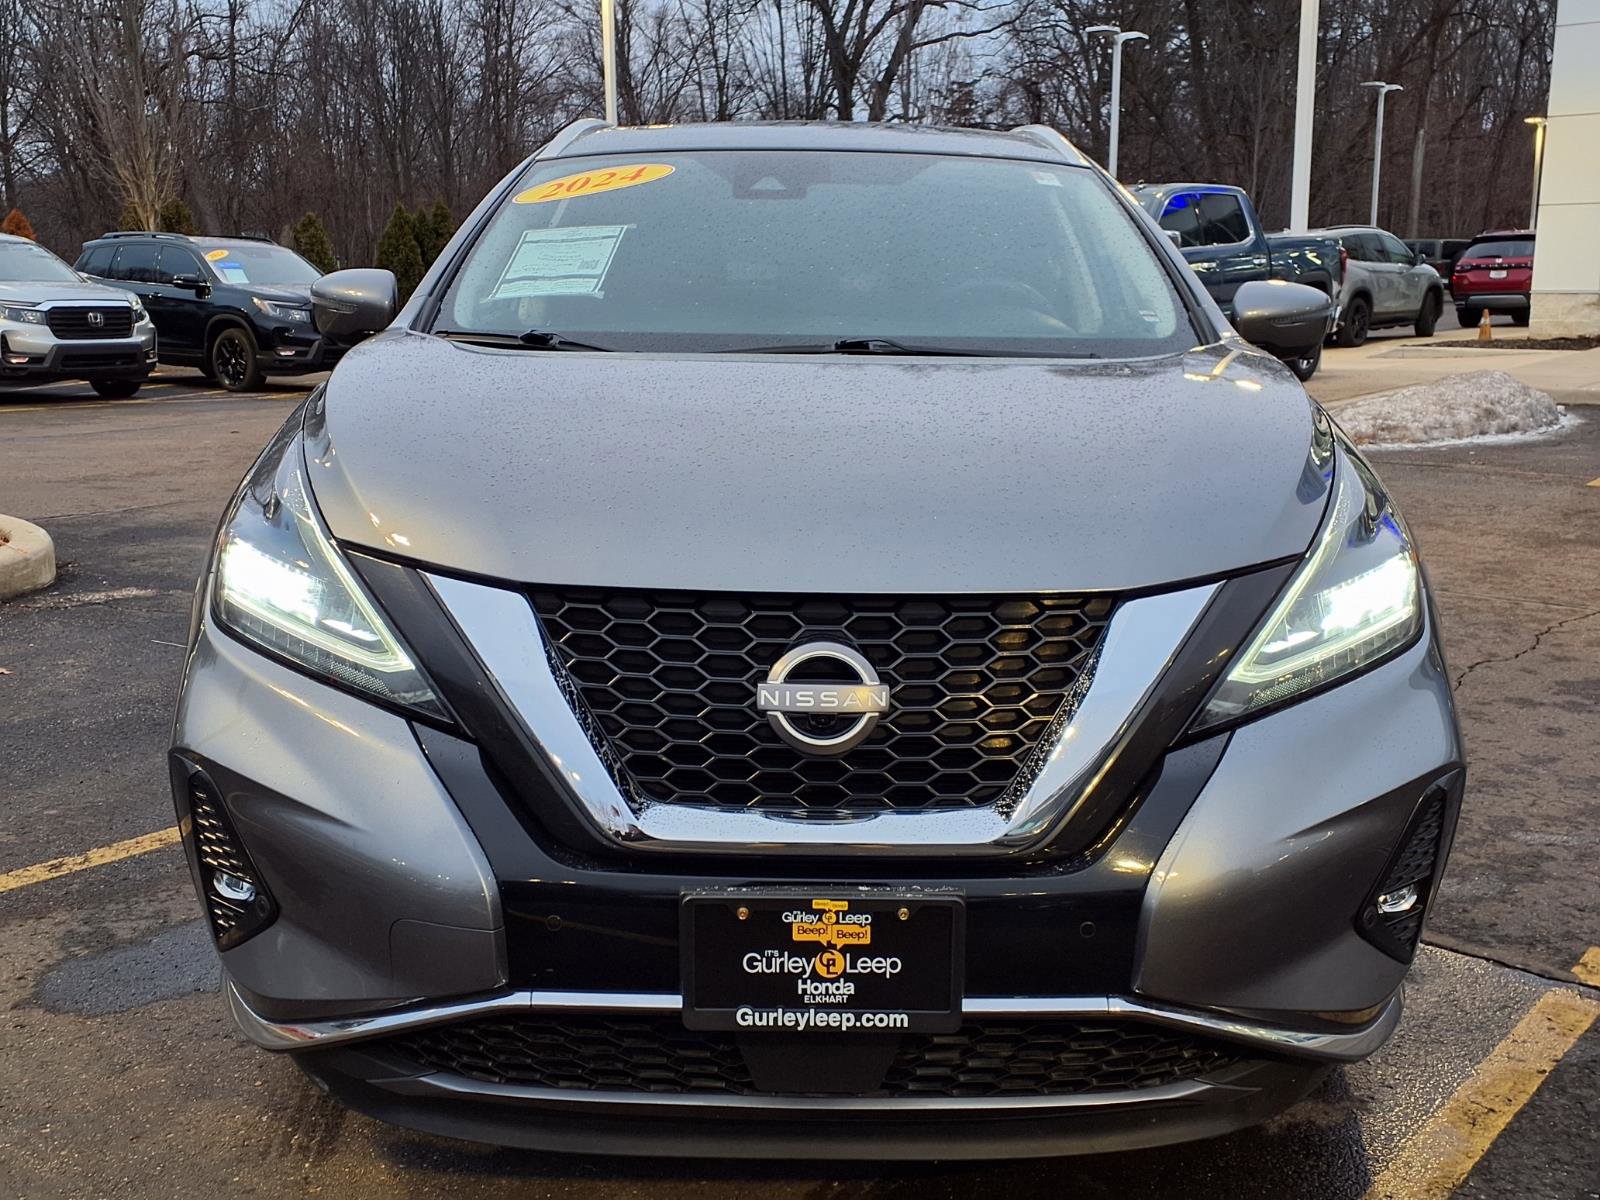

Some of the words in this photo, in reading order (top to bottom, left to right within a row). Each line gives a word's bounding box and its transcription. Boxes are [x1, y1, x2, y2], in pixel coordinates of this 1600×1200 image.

[539, 166, 648, 199] 2024
[760, 689, 887, 707] NISSAN
[839, 911, 872, 927] Leep
[797, 925, 829, 937] Beep!
[836, 929, 868, 941] Beep!
[764, 950, 780, 958] IT'S
[742, 951, 816, 979] Gurley
[846, 953, 902, 979] Leep
[797, 978, 855, 995] Honda
[804, 995, 849, 1004] ELKHART
[736, 1007, 909, 1031] Gurleyleep.com
